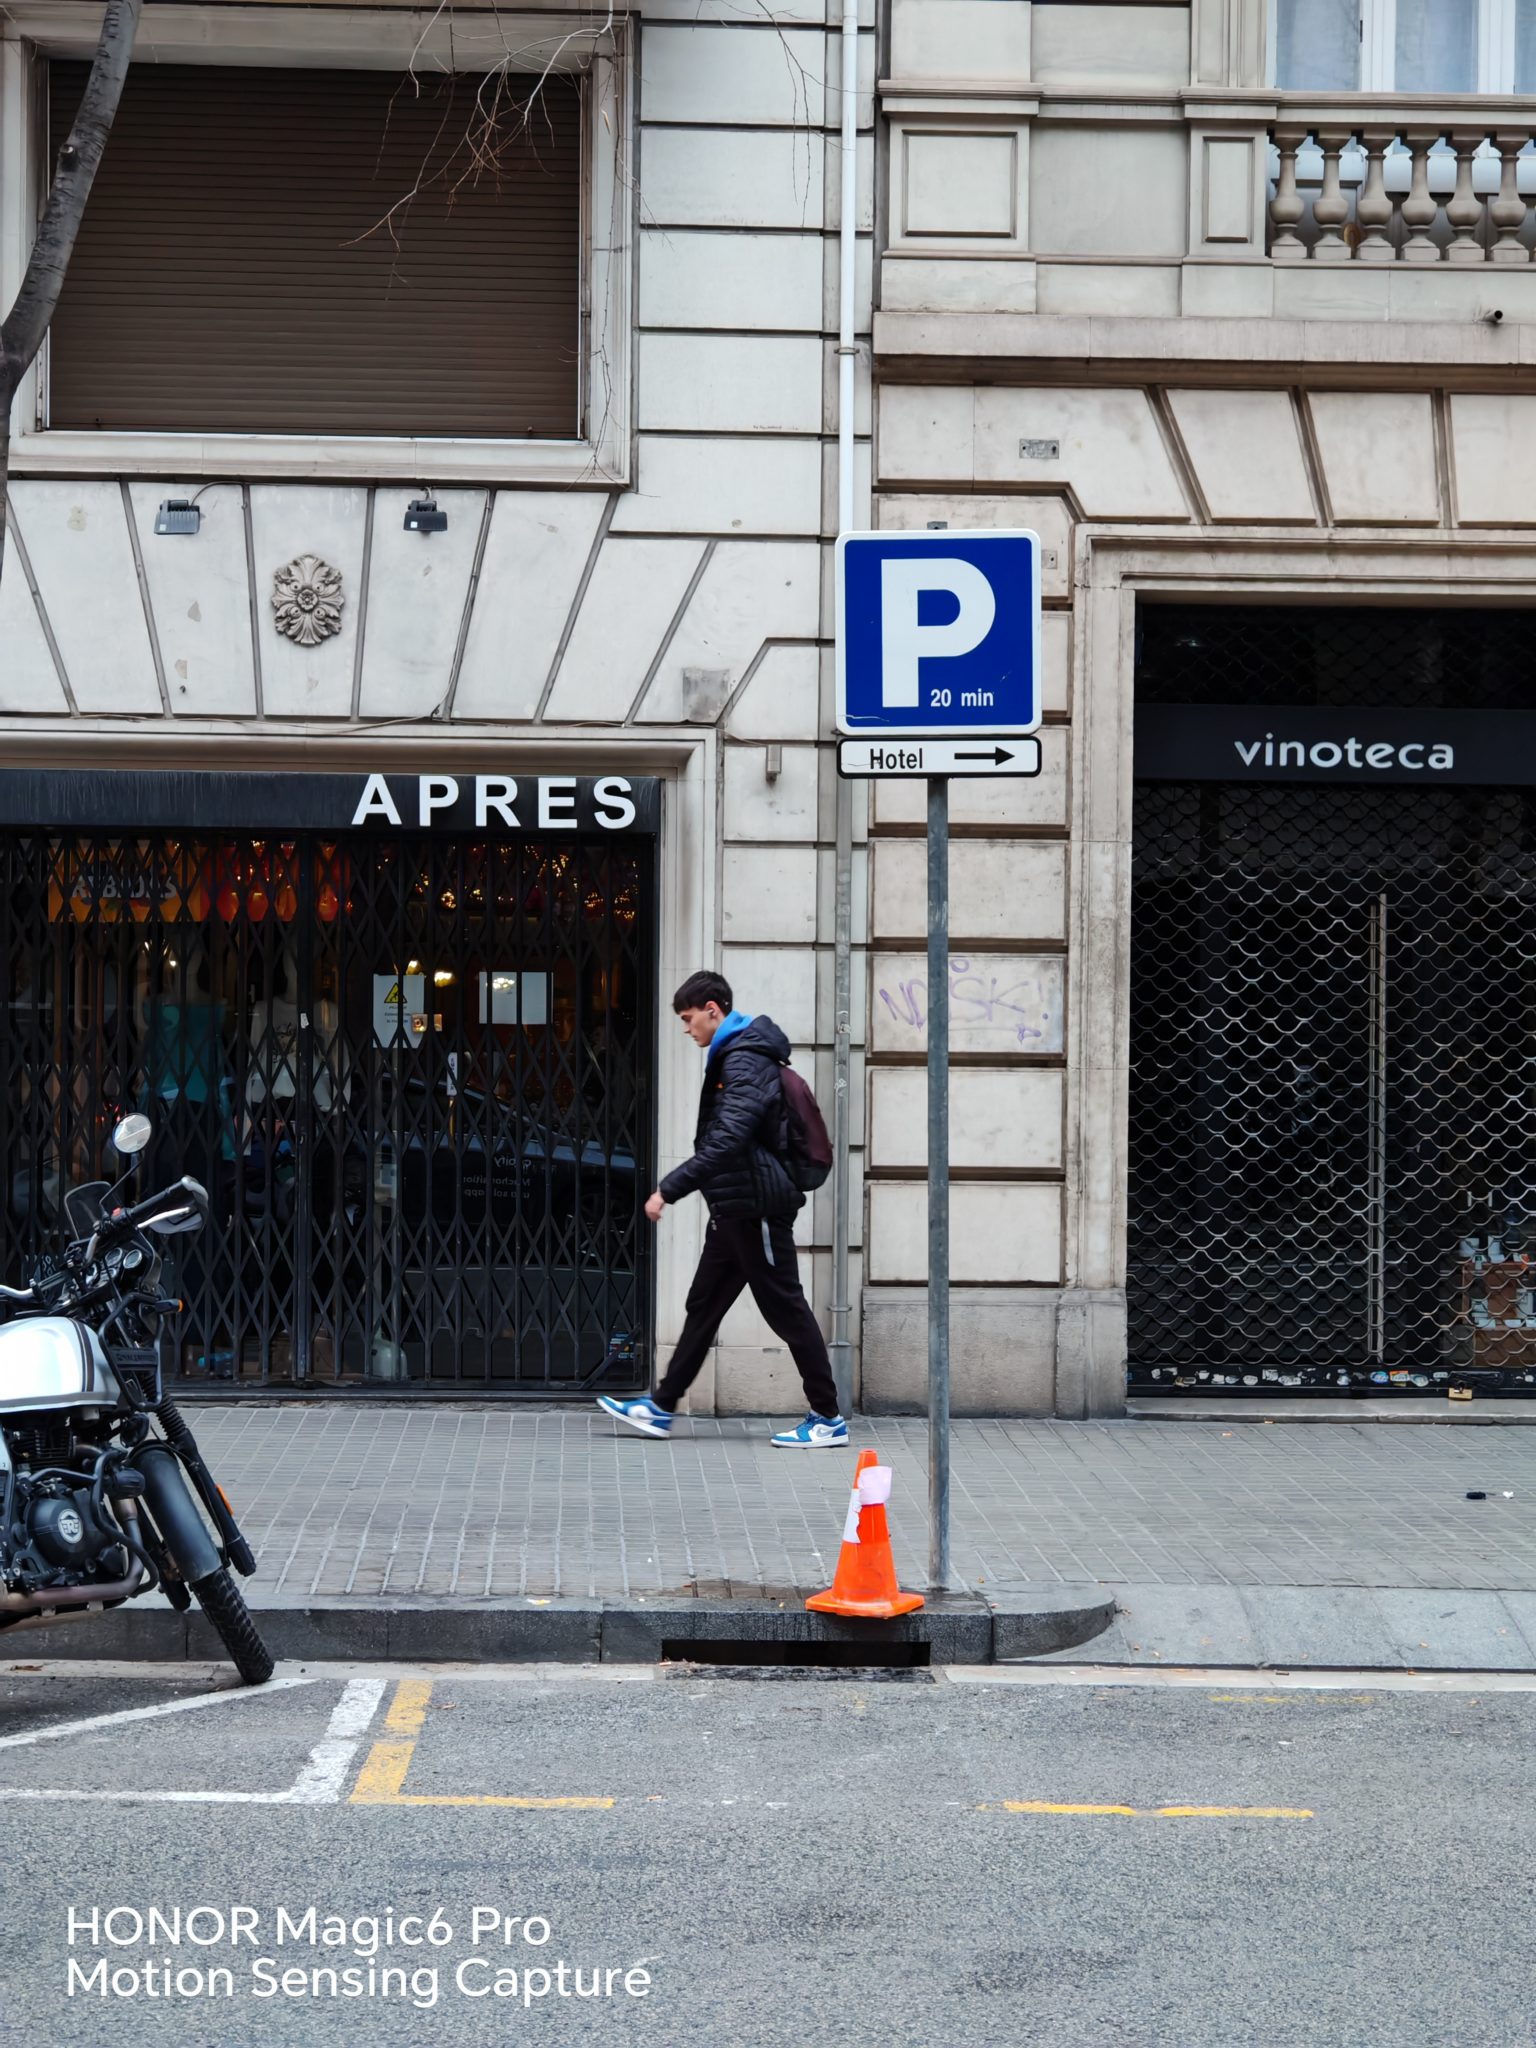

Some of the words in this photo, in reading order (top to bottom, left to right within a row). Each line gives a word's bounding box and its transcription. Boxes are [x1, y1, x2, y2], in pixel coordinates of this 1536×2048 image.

[881, 559, 996, 708] P
[930, 688, 952, 707] 20
[960, 688, 994, 707] min
[869, 746, 923, 770] Hotel
[1234, 732, 1455, 770] vinoteca
[351, 773, 636, 829] APRES
